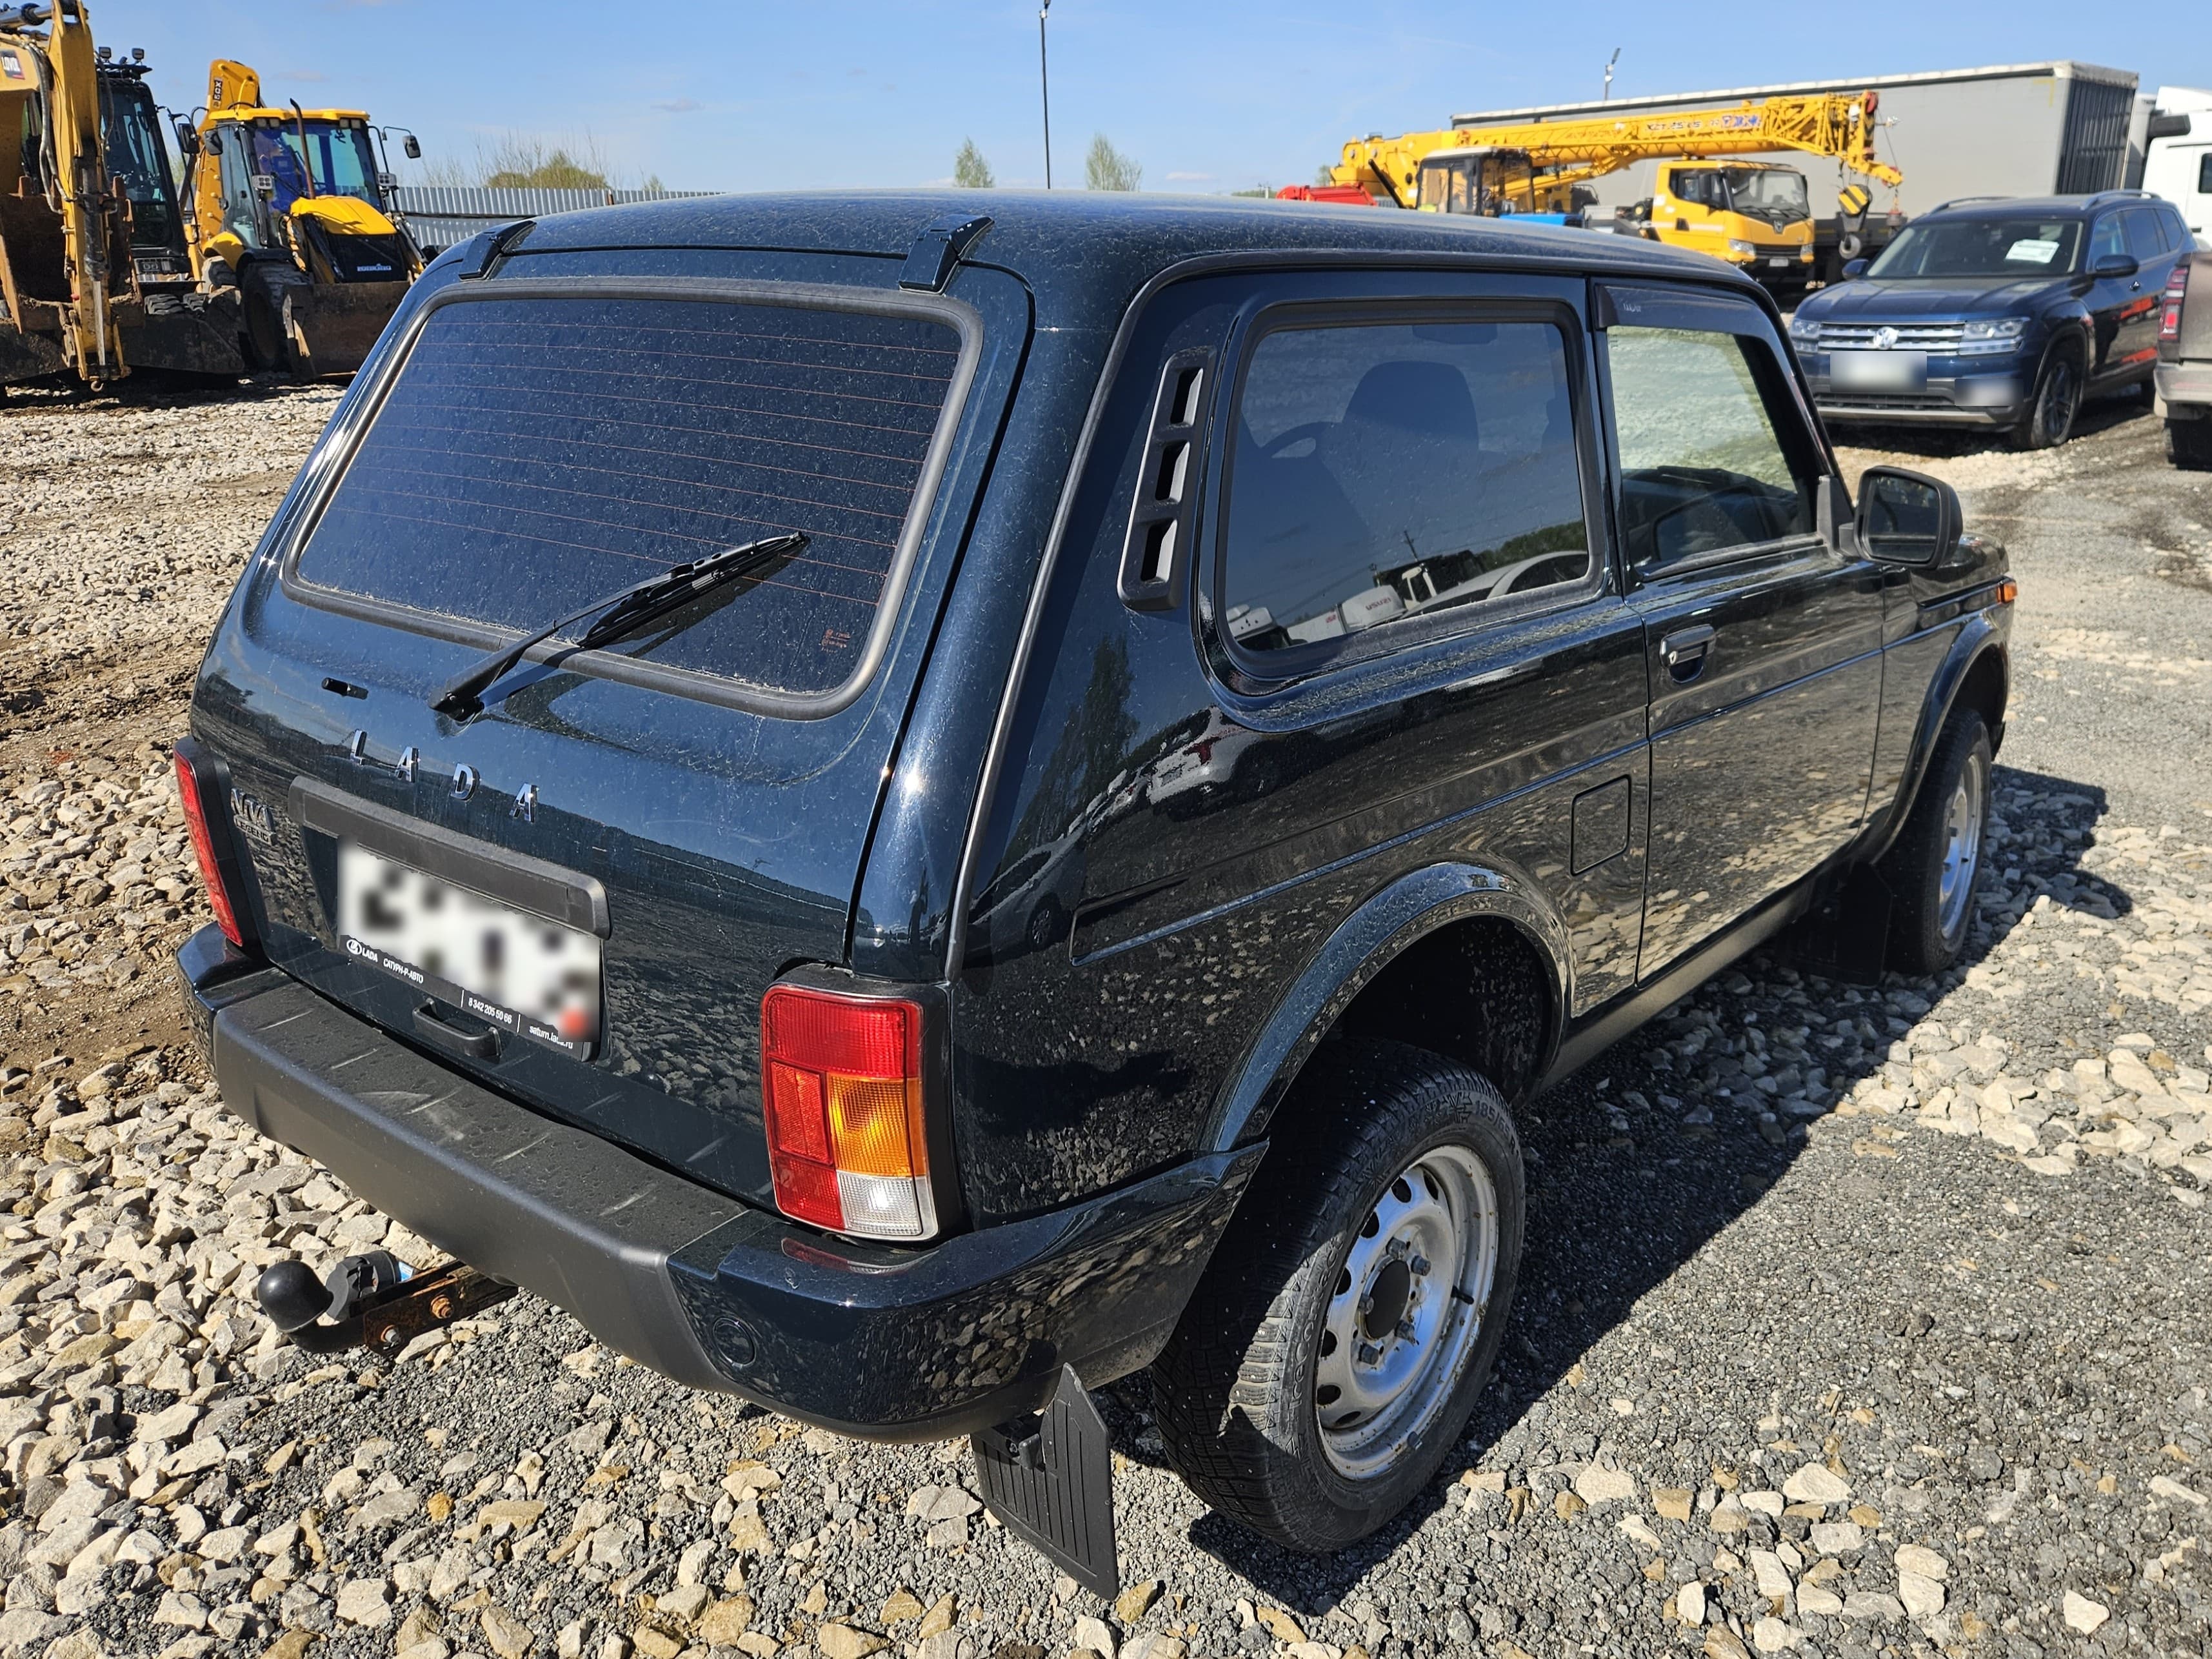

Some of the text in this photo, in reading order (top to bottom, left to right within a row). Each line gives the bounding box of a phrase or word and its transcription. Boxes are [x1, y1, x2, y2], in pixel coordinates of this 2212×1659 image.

[350, 729, 539, 823] LADA
[231, 788, 276, 833] NIVA
[235, 818, 270, 843] LEGEND
[362, 947, 378, 963] LADA
[383, 958, 424, 984] САТУРН-Р-АВТО
[468, 998, 473, 1007] 8
[473, 999, 484, 1012] 342
[484, 1004, 495, 1017] 205
[495, 1009, 503, 1021] 50
